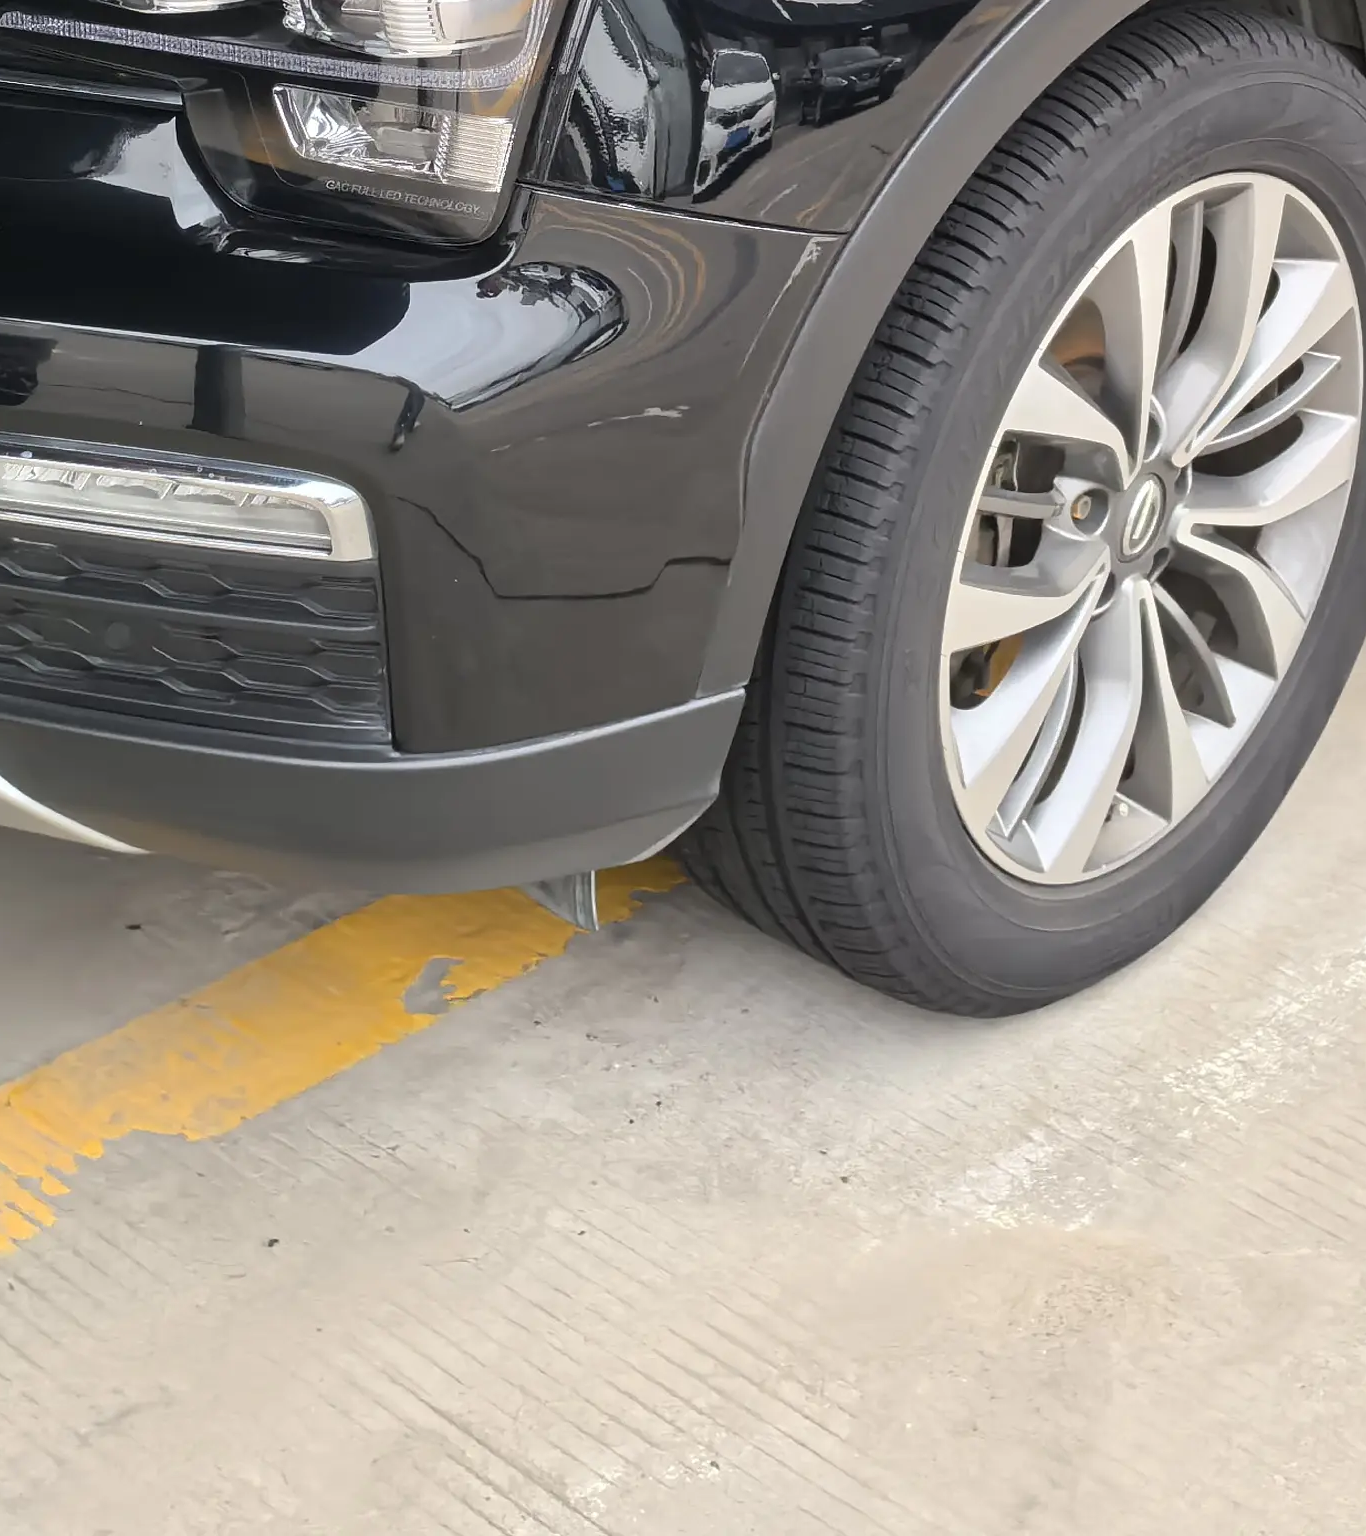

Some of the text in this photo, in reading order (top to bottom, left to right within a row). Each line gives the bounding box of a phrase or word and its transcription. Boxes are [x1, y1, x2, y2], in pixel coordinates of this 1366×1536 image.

[325, 179, 481, 215] GAC FULL LED TECHNOLOGY
